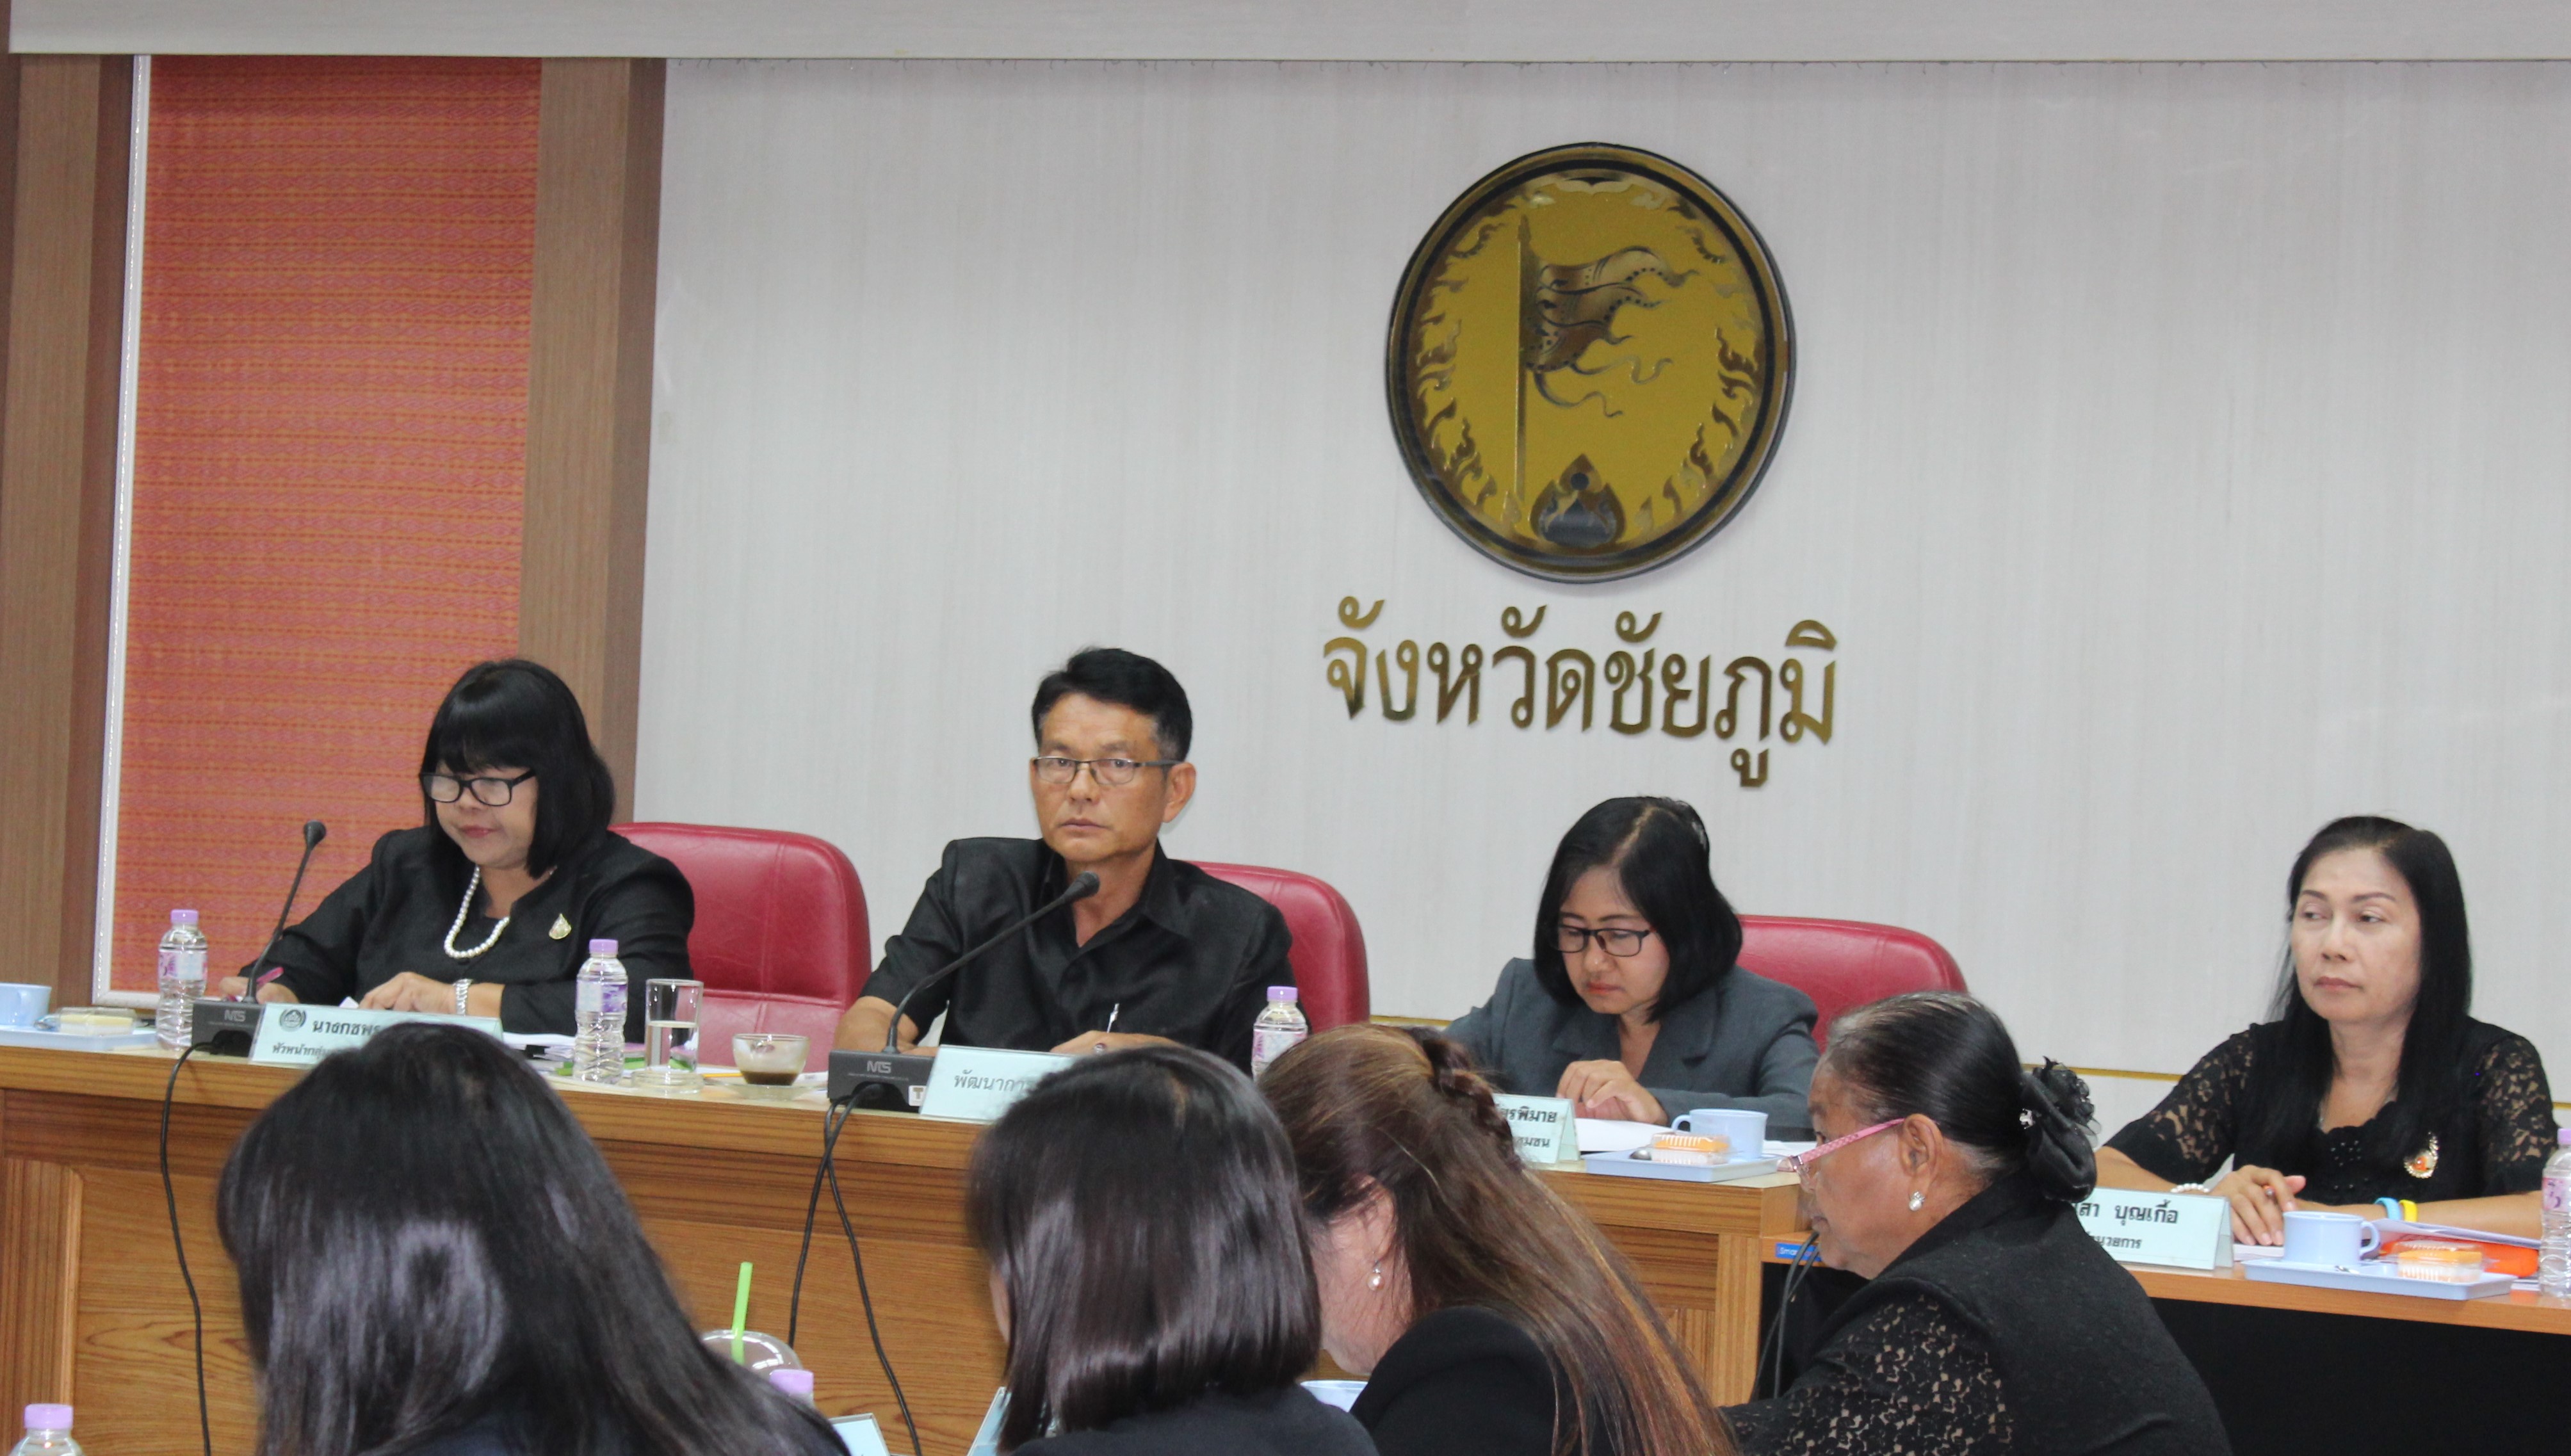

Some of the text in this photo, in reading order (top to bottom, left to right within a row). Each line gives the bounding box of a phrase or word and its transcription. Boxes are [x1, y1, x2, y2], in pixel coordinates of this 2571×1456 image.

[1323, 595, 1837, 788] จังหวัดชัยภูมิ
[2114, 1199, 2178, 1225] บุญเกื้อ
